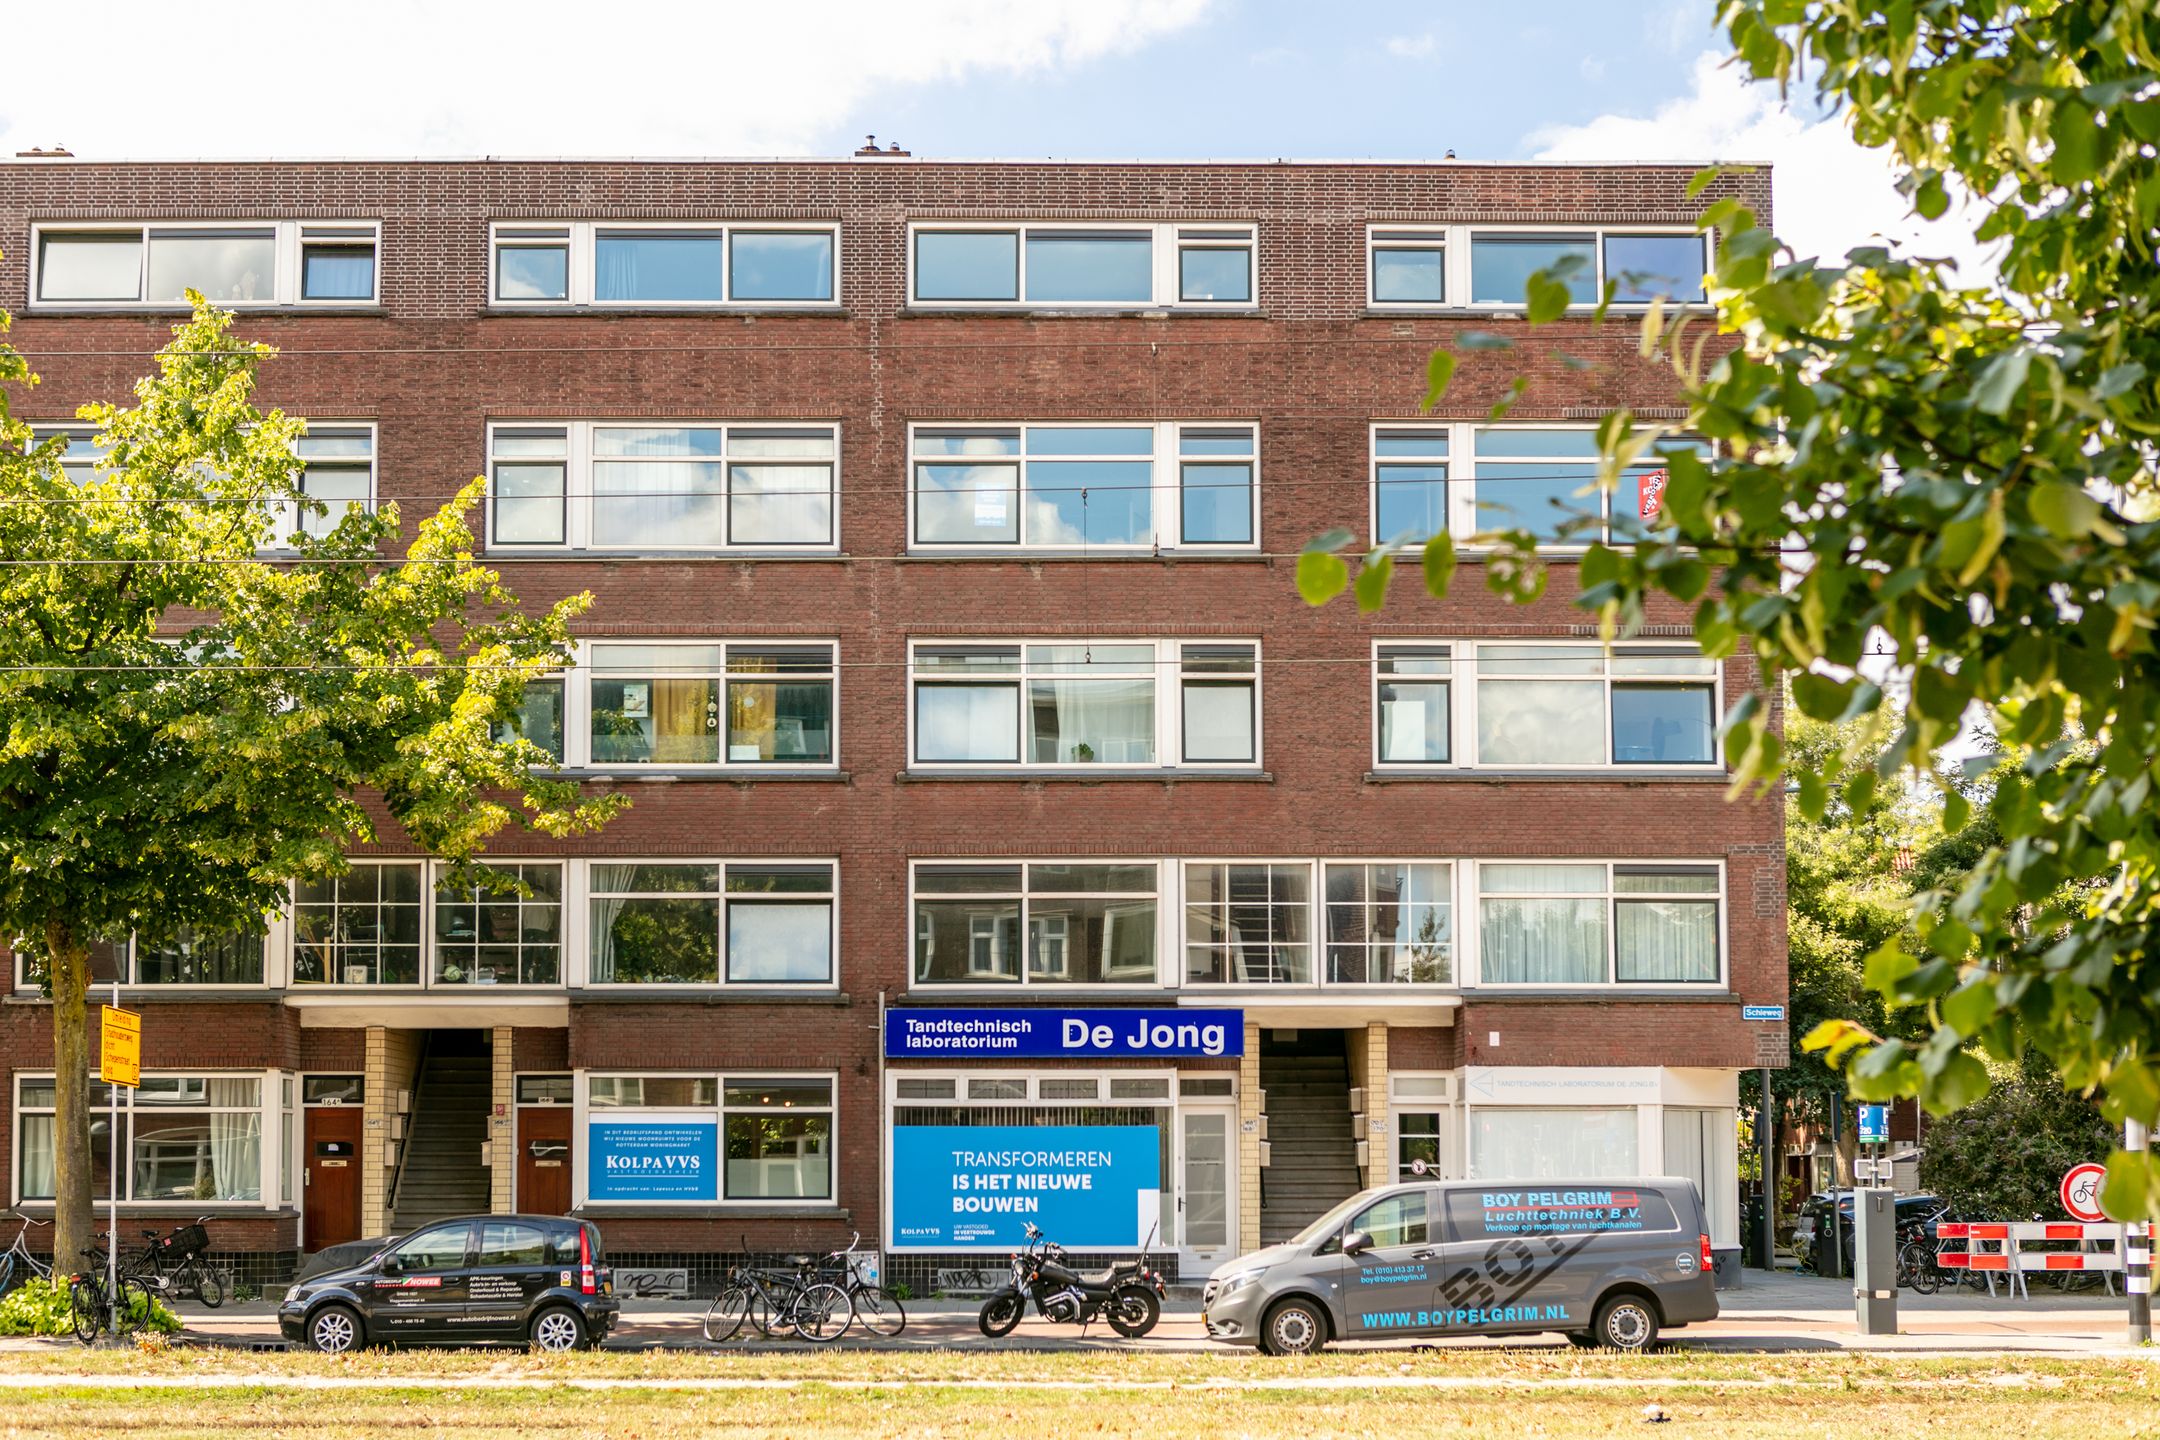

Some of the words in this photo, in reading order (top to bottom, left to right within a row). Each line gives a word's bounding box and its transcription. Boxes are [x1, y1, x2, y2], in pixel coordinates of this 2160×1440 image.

[1745, 1008, 1782, 1018] Schieweg
[906, 1019, 1032, 1033] Tandtechnisch
[1062, 1018, 1114, 1048] De
[1127, 1018, 1225, 1055] Jong
[906, 1034, 1018, 1048] laboratorium
[1497, 1080, 1557, 1088] TANDTECHNISCH
[1559, 1080, 1615, 1088] LABORATORIUM
[952, 1151, 1112, 1168] TRANSFORMEREN
[953, 1174, 970, 1190] IS
[974, 1174, 1012, 1190] HET
[1016, 1174, 1092, 1190] NIEUWE
[953, 1197, 1038, 1212] BOUWEN
[1482, 1193, 1521, 1207] BOY
[1527, 1192, 1612, 1206] PELGRIM
[1485, 1208, 1604, 1222] Luchttechniek
[1610, 1208, 1642, 1219] B.V.
[1485, 1224, 1520, 1232] Verkoop
[1534, 1223, 1570, 1231] montage
[1588, 1221, 1642, 1229] luchtkanalen
[1375, 1267, 1393, 1275] (010)
[410, 1278, 440, 1286] NOWEE
[1360, 1273, 1427, 1284] boy@boypelgrim.nl
[446, 1314, 517, 1323] www.autobedrijfnowee.nl
[1362, 1304, 1570, 1329] WWW.BOYPELGRIM.NL
